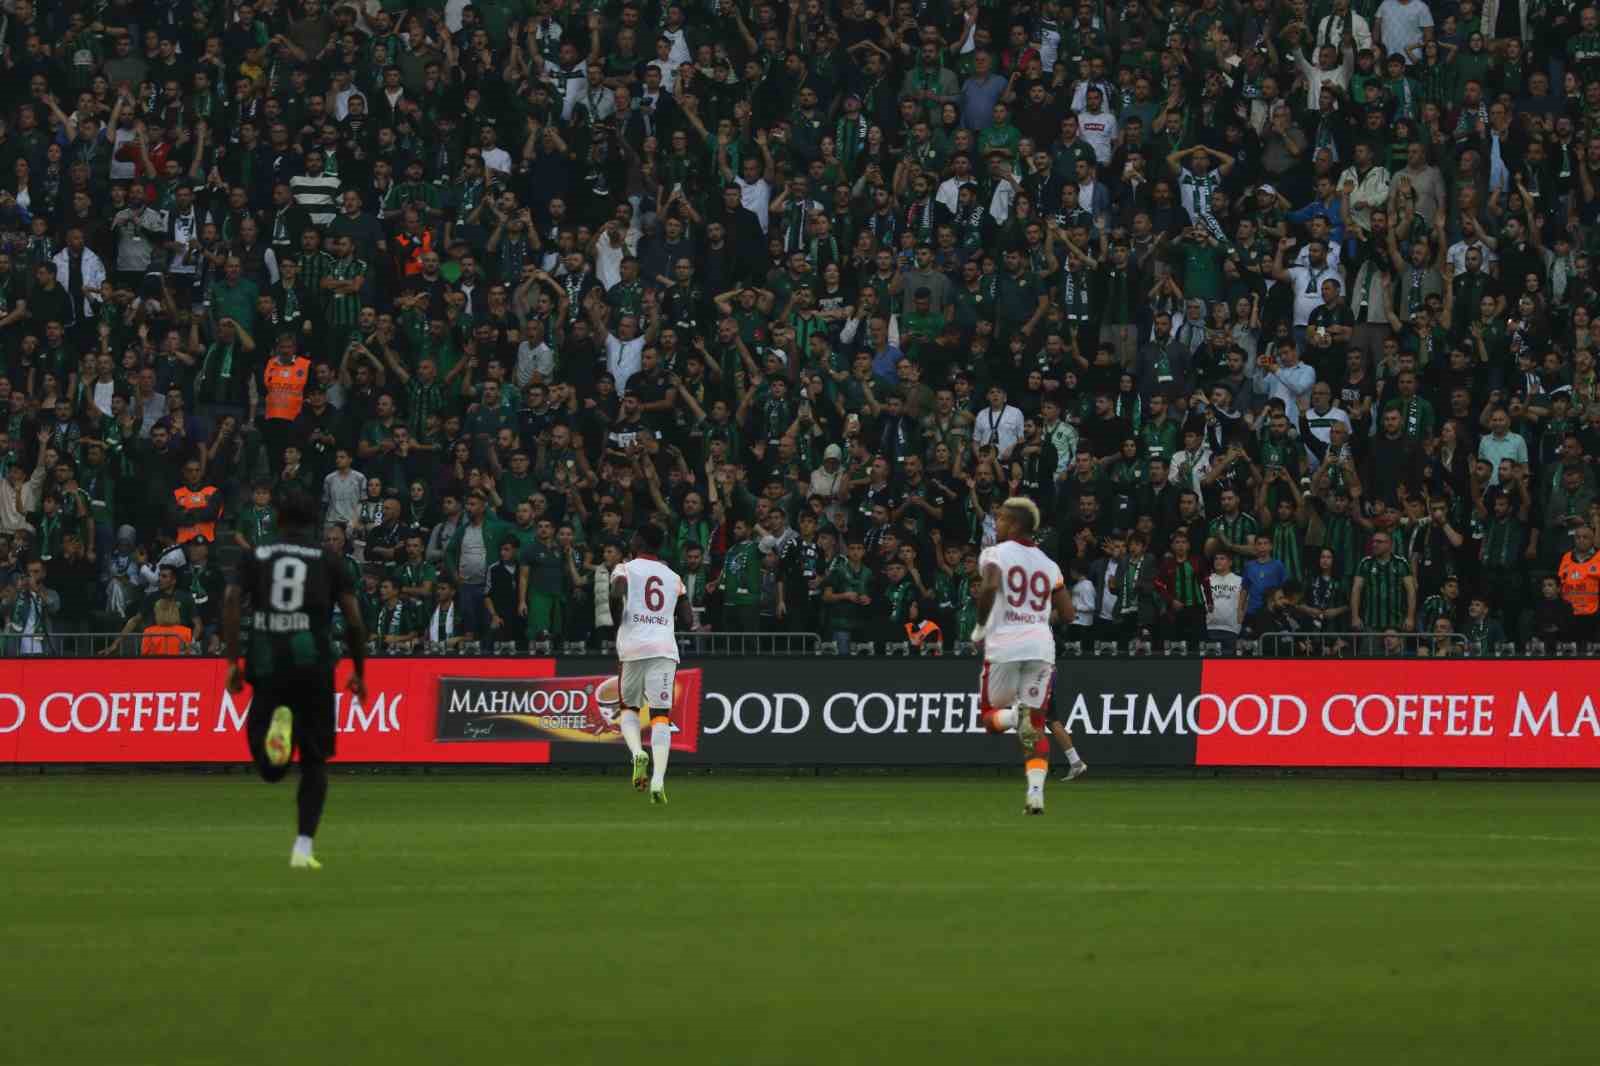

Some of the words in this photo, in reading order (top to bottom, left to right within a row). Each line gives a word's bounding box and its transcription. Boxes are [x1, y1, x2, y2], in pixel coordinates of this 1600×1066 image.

[270, 556, 307, 611] 8
[644, 575, 664, 612] 6
[1008, 565, 1050, 611] 99
[39, 692, 201, 733] COFFEE
[448, 688, 589, 714] MAHMOOD
[823, 692, 987, 734] COFFEE
[1004, 692, 1308, 736] AHMOOD
[1321, 693, 1495, 737] COFFEE
[542, 715, 588, 729] COFFEE
